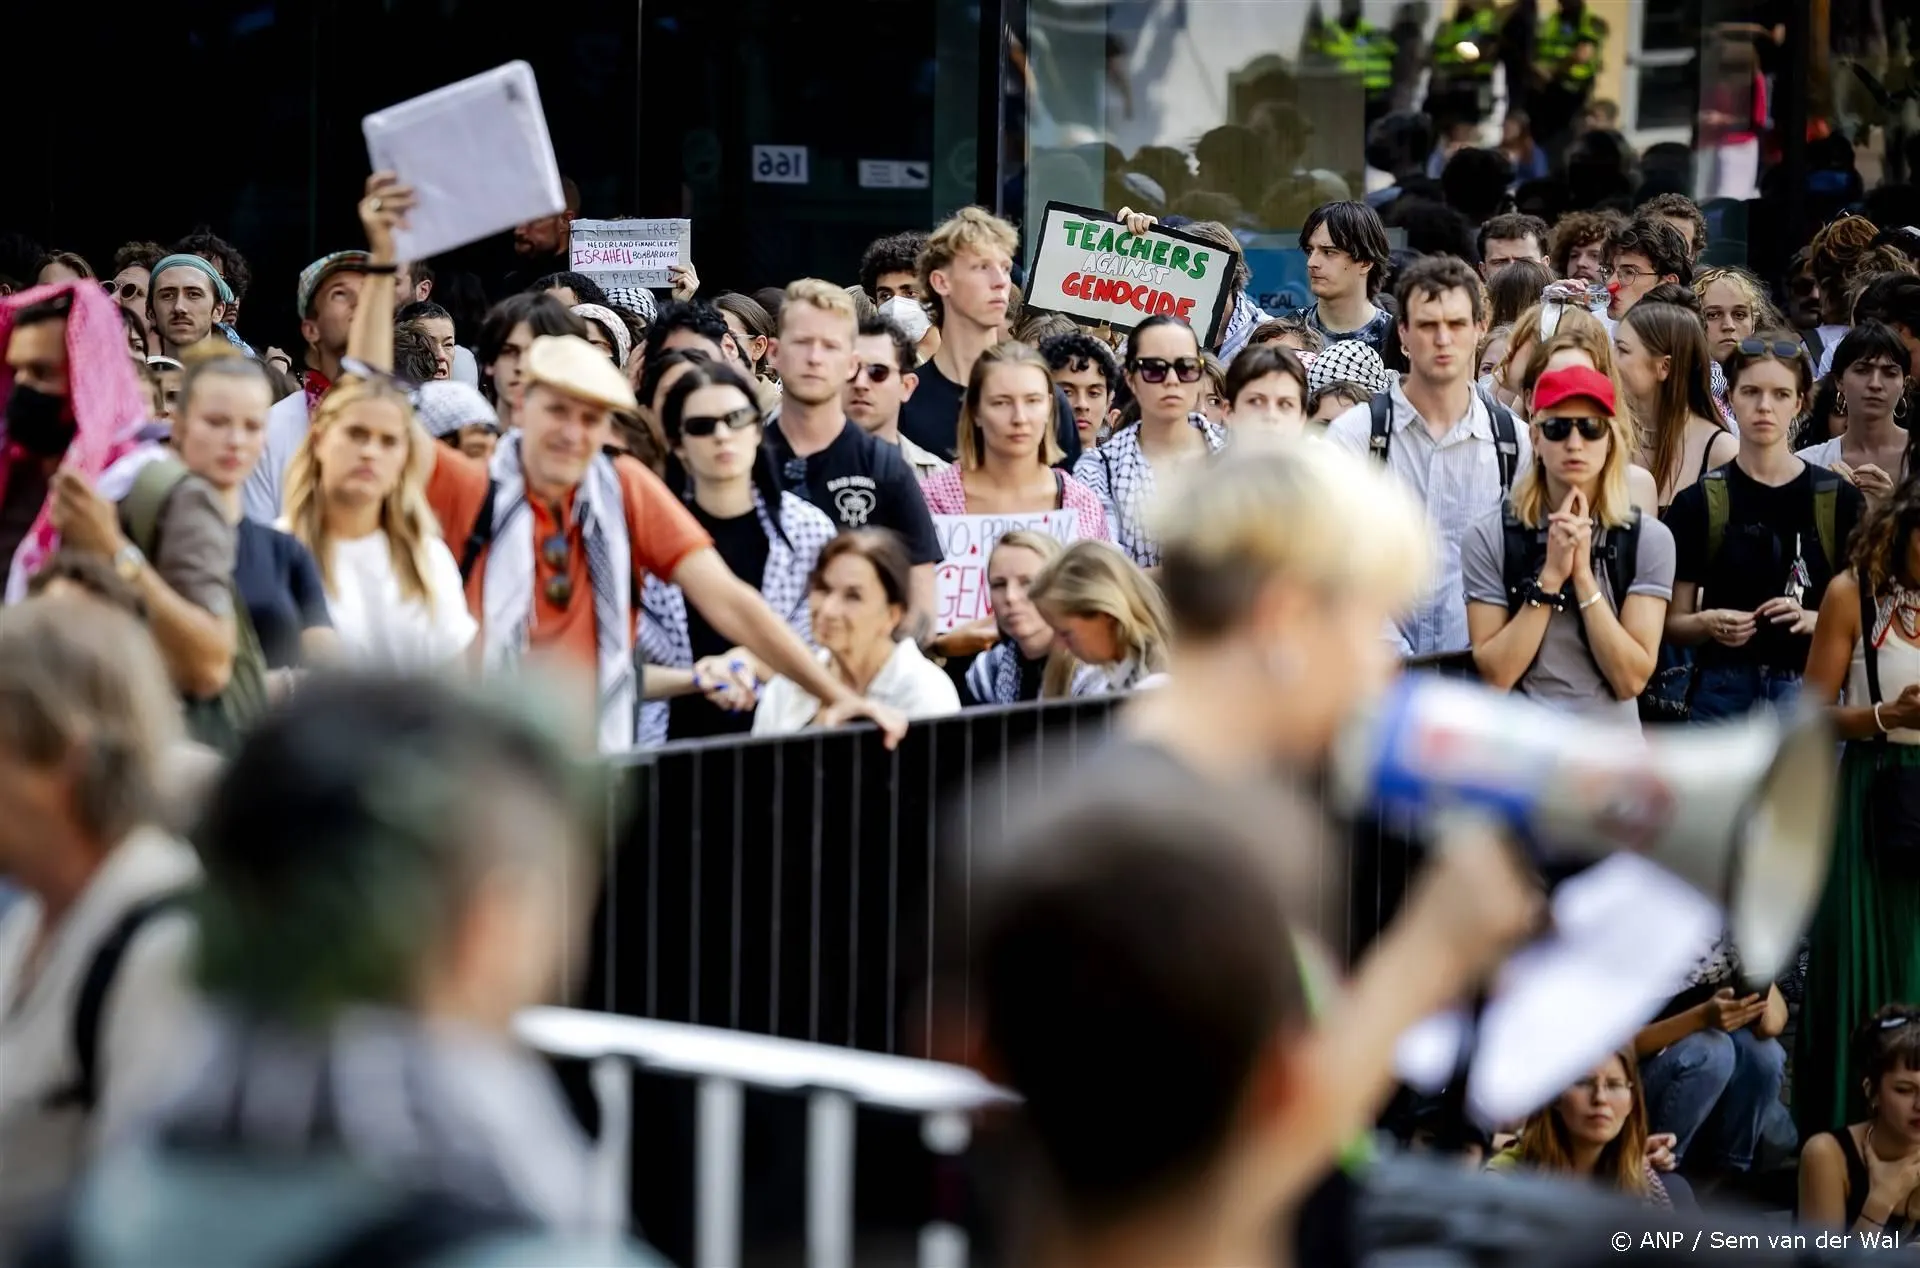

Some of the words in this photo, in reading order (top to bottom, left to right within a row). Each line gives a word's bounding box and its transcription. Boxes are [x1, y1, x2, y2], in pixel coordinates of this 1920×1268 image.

[647, 223, 679, 235] FREE
[573, 248, 633, 265] ISRAHELL
[633, 251, 679, 260] BOMBARDEERT
[587, 241, 634, 249] NEDERLAND
[1063, 220, 1210, 280] TEACHERS
[613, 271, 676, 284] PALESTIN
[1081, 252, 1170, 285] AGAINST
[1061, 271, 1196, 325] GENOCIDE
[936, 564, 994, 620] GEN
